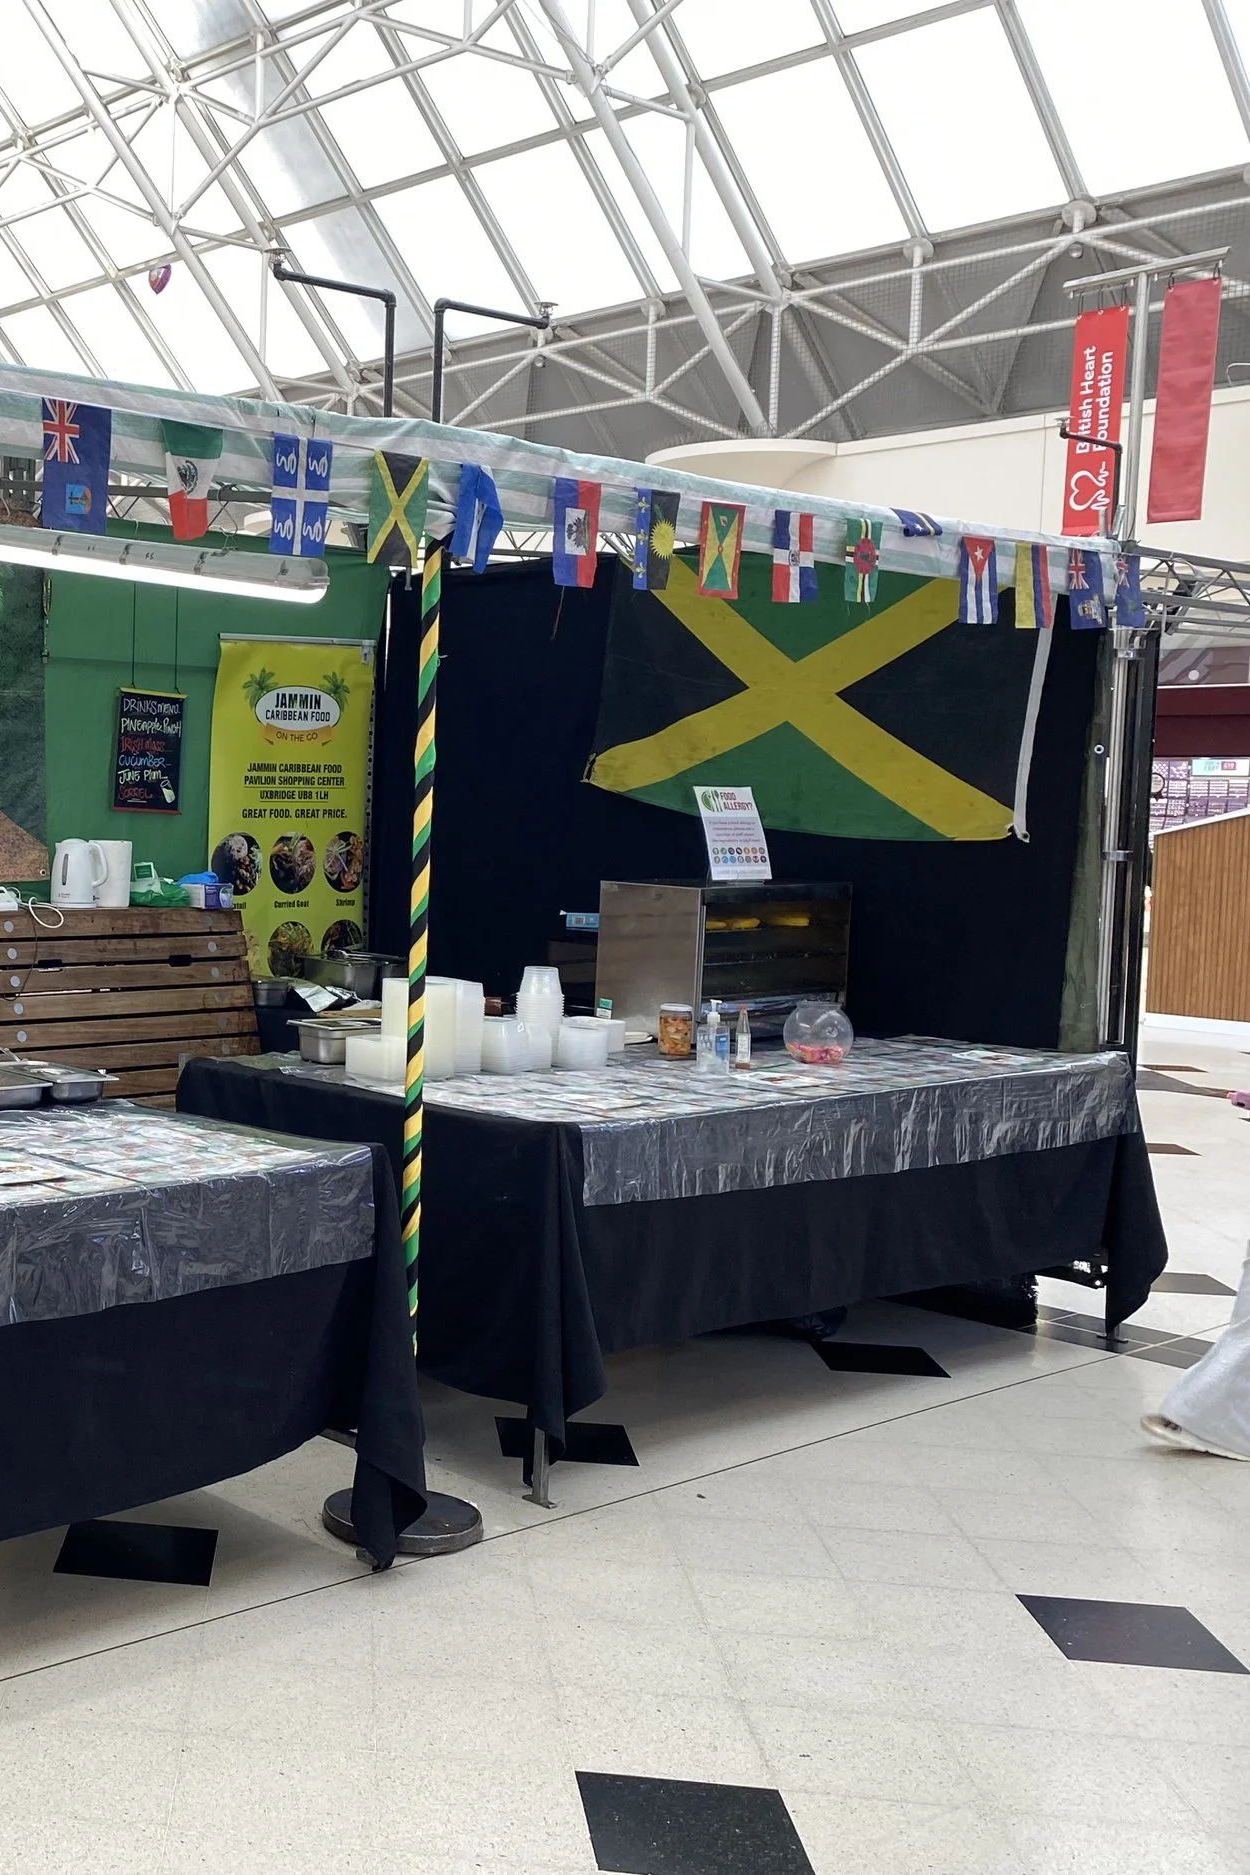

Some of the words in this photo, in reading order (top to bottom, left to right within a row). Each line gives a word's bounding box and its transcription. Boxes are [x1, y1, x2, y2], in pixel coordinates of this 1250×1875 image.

[1080, 345, 1097, 395] Heart
[1076, 398, 1093, 454] Bitish
[275, 692, 322, 709] JAMMIN
[265, 709, 309, 721] CARIBBEAN
[311, 711, 331, 722] FOOD
[276, 731, 287, 740] ON
[290, 734, 304, 742] THE
[306, 732, 318, 741] GO
[247, 762, 277, 774] JAMMIN
[278, 763, 321, 774] CARIBBEAN
[323, 763, 342, 774] FOOD
[244, 775, 276, 785] PAVILION
[278, 776, 315, 786] SHOPPING
[317, 776, 345, 786] CENTER
[259, 790, 296, 800] UXBRIDGE
[298, 790, 313, 800] UB8
[315, 790, 329, 800] 1LH
[719, 791, 737, 801] FOOD
[723, 801, 753, 811] ALLERGY?
[242, 808, 267, 818] GREAT
[270, 808, 292, 818] FOOD.
[295, 808, 320, 818] GREAT
[322, 808, 348, 819] PRICE.
[231, 902, 247, 910] xtail
[273, 900, 295, 908] Curried
[296, 900, 309, 908] Goat
[335, 898, 356, 907] Shrimp
